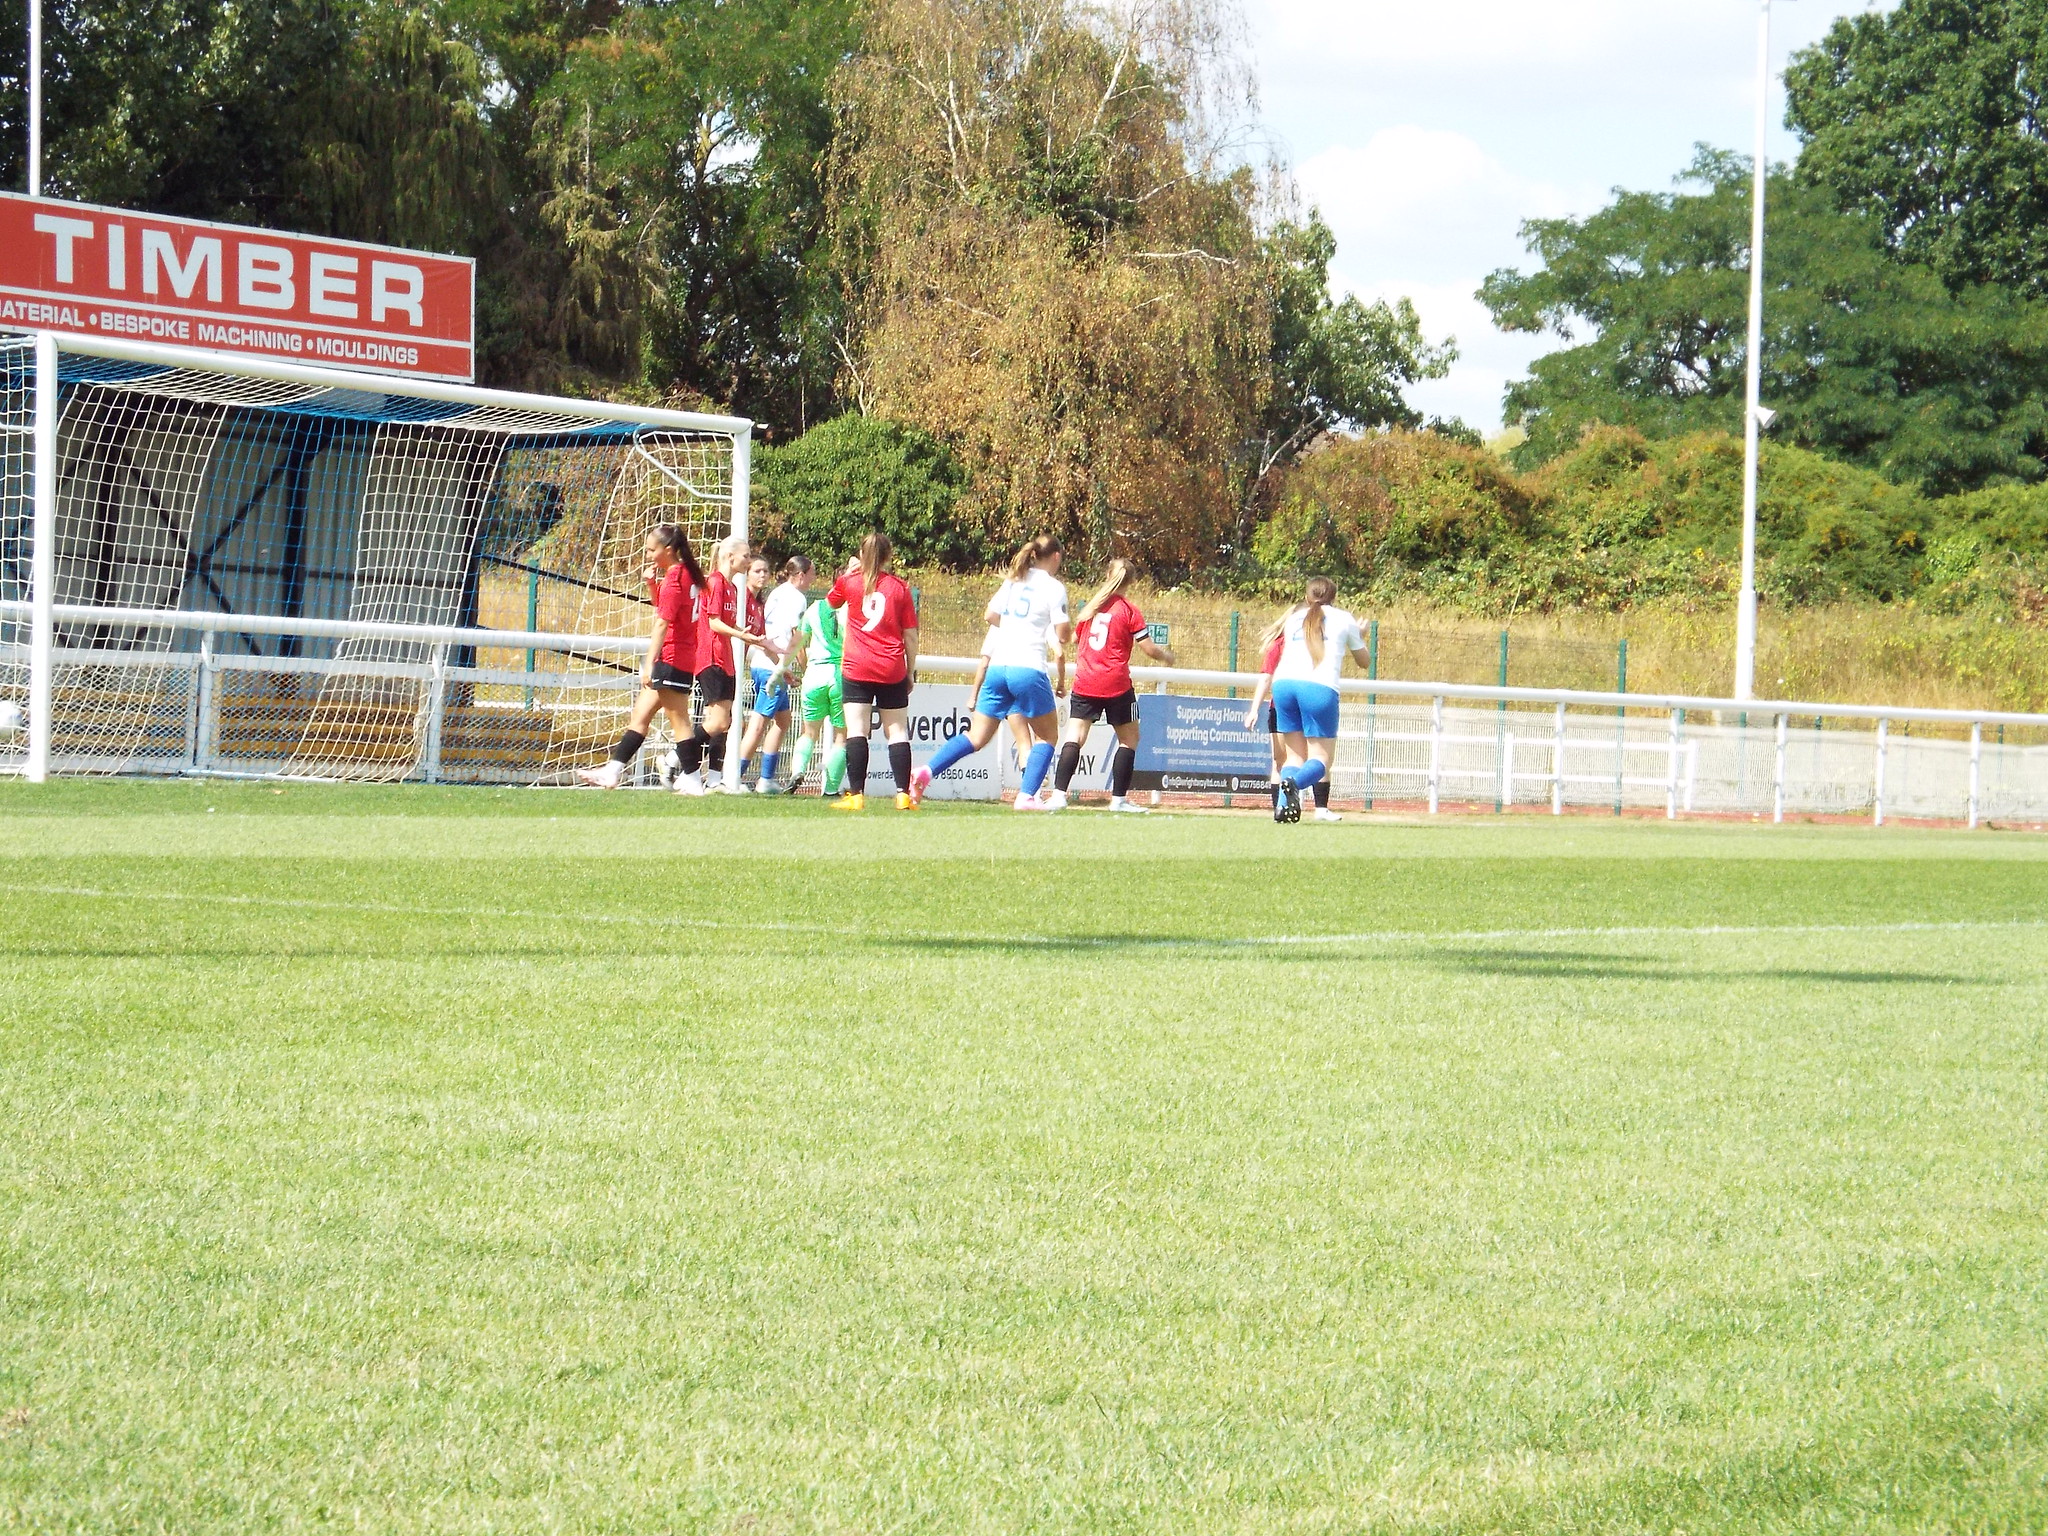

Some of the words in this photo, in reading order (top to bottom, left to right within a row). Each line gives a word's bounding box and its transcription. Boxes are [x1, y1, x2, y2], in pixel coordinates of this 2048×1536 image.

[34, 213, 425, 327] TIMBER
[0, 300, 85, 327] ATERIAL
[101, 312, 190, 339] BESPOKE
[198, 323, 302, 352] MACHINING
[316, 337, 419, 366] MOULDINGS
[861, 591, 886, 632] 9
[1088, 612, 1113, 651] 5
[1176, 704, 1223, 726] Supporting
[1166, 725, 1209, 746] Supporting
[1209, 727, 1270, 745] Communities
[965, 768, 989, 780] 4646
